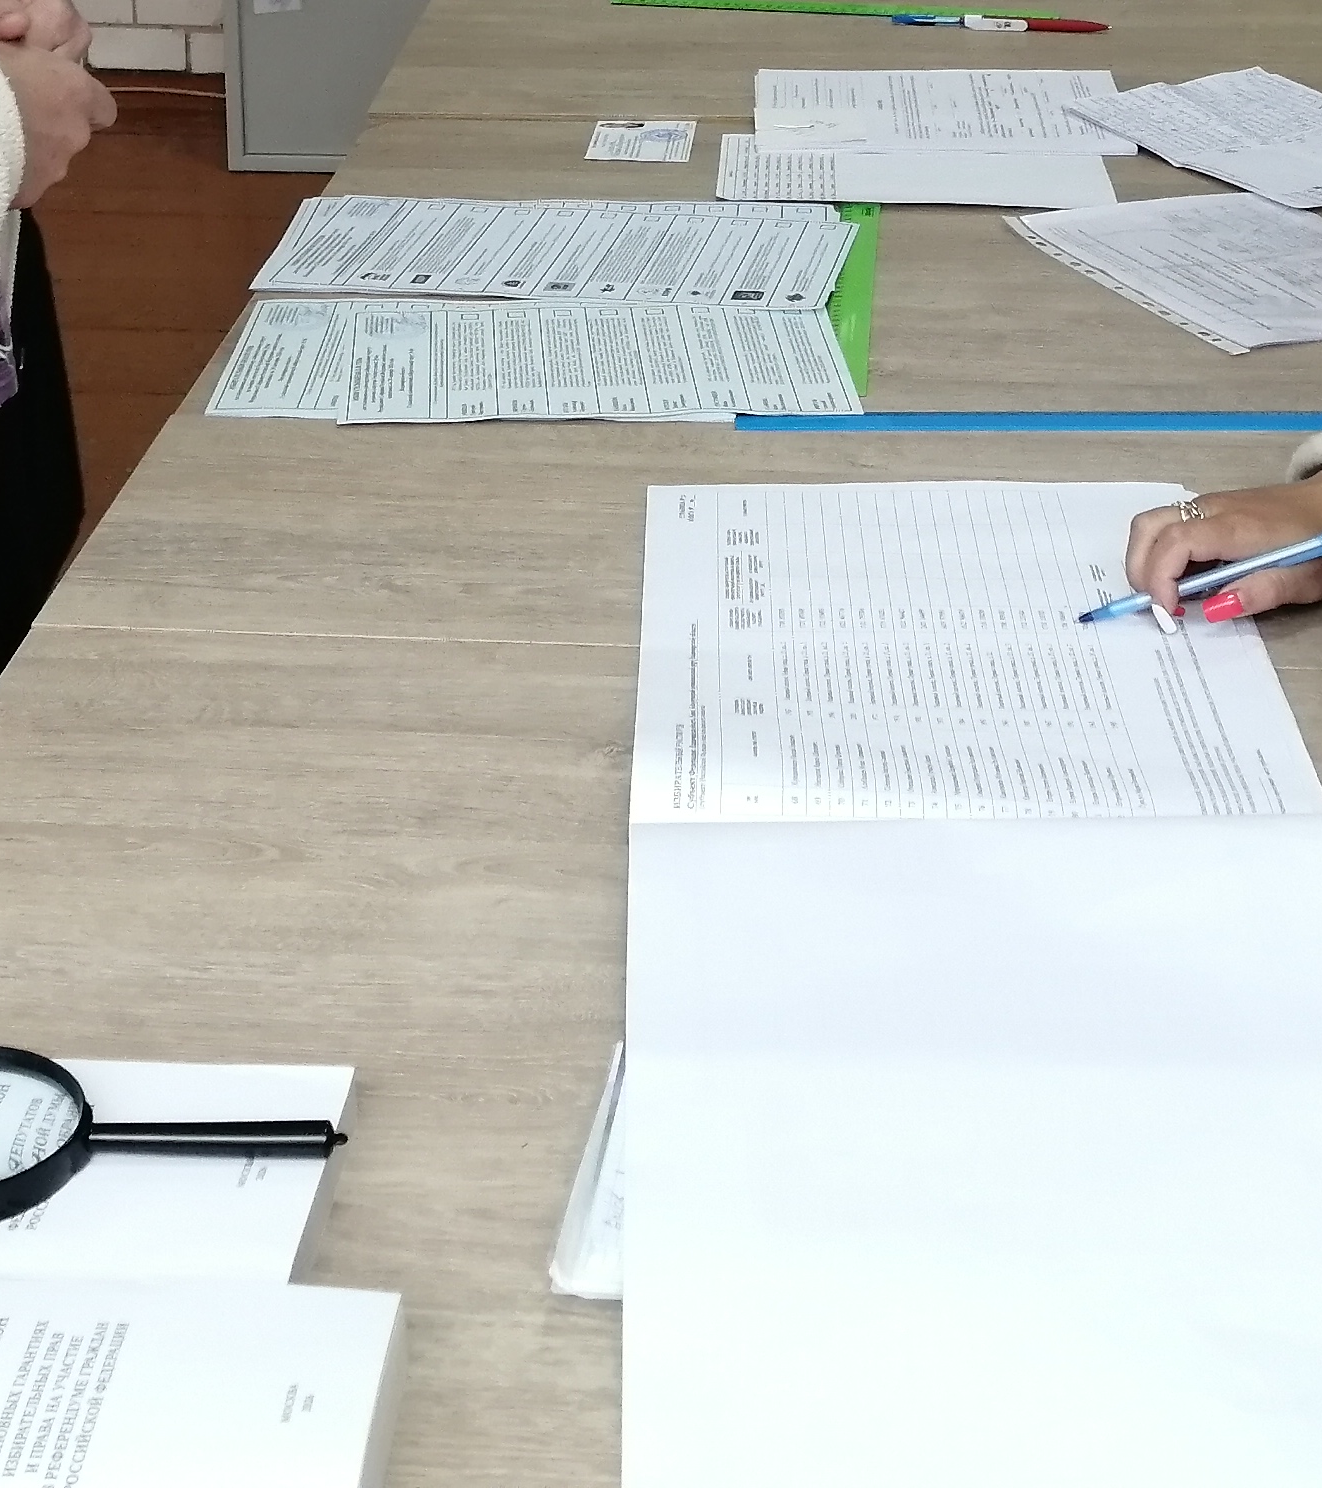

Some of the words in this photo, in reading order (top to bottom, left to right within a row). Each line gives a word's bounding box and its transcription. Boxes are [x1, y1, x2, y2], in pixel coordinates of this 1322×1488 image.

[13, 1320, 50, 1387] ГАРАНТИЯХ
[53, 1335, 85, 1391] УЧАСТИЕ
[94, 1322, 130, 1394] ФЕДЕРАЦИИ
[2, 1364, 53, 1477] ИЗБИРАТЕЛЬНЫХ
[43, 1332, 65, 1360] ПРАВ
[45, 1379, 89, 1480] РЕФЕРЕНДУМЕ
[79, 1321, 110, 1379] ГРАЖДАН
[45, 1394, 64, 1413] НА
[25, 1462, 39, 1473] И
[29, 1416, 56, 1459] ПРАВА
